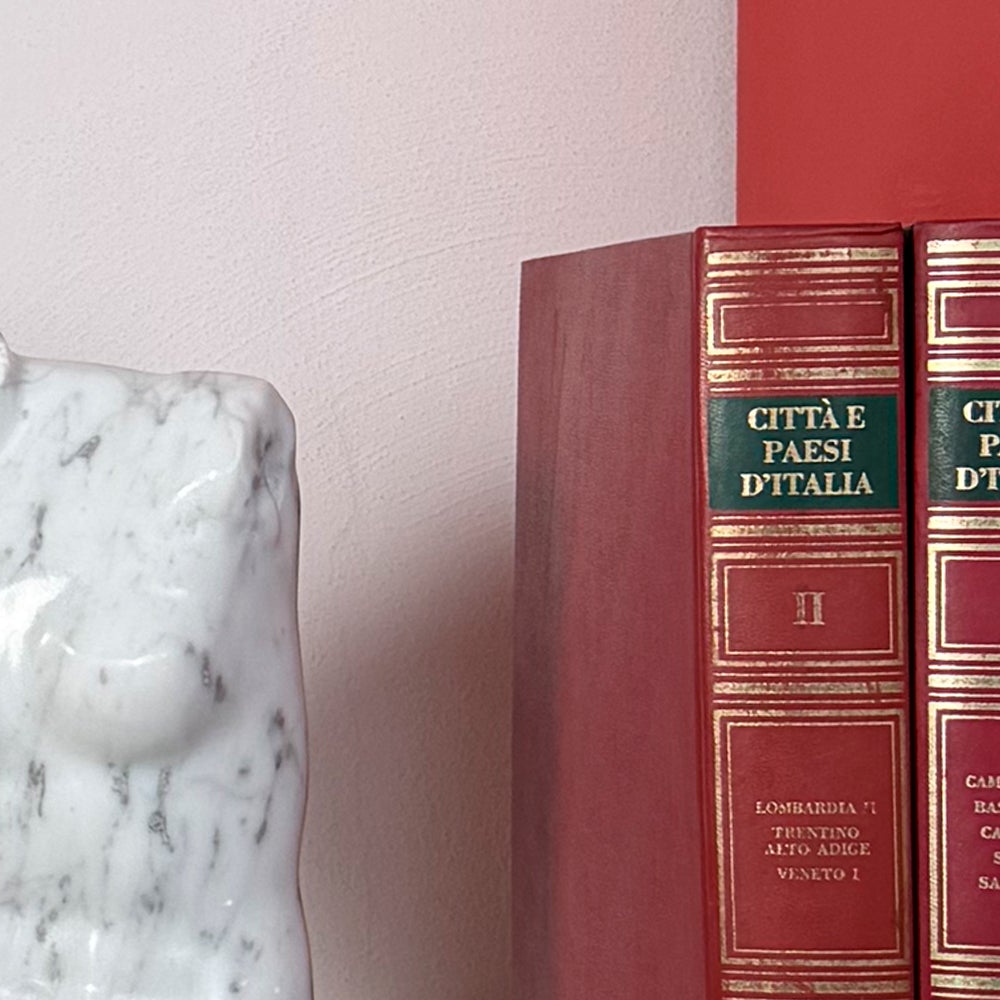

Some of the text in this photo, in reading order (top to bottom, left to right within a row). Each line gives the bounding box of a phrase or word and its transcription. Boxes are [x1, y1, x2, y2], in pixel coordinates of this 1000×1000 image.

[748, 398, 866, 430] CITTÀ E
[963, 400, 1000, 424] CI
[762, 439, 852, 464] PAESI
[979, 434, 1000, 457] P
[740, 472, 874, 497] D'ITALIA
[793, 592, 825, 626] II
[756, 801, 856, 814] LOMBARDIA
[771, 827, 860, 839] TRENTINO
[817, 843, 871, 855] ADIGE
[777, 867, 845, 880] VENETO
